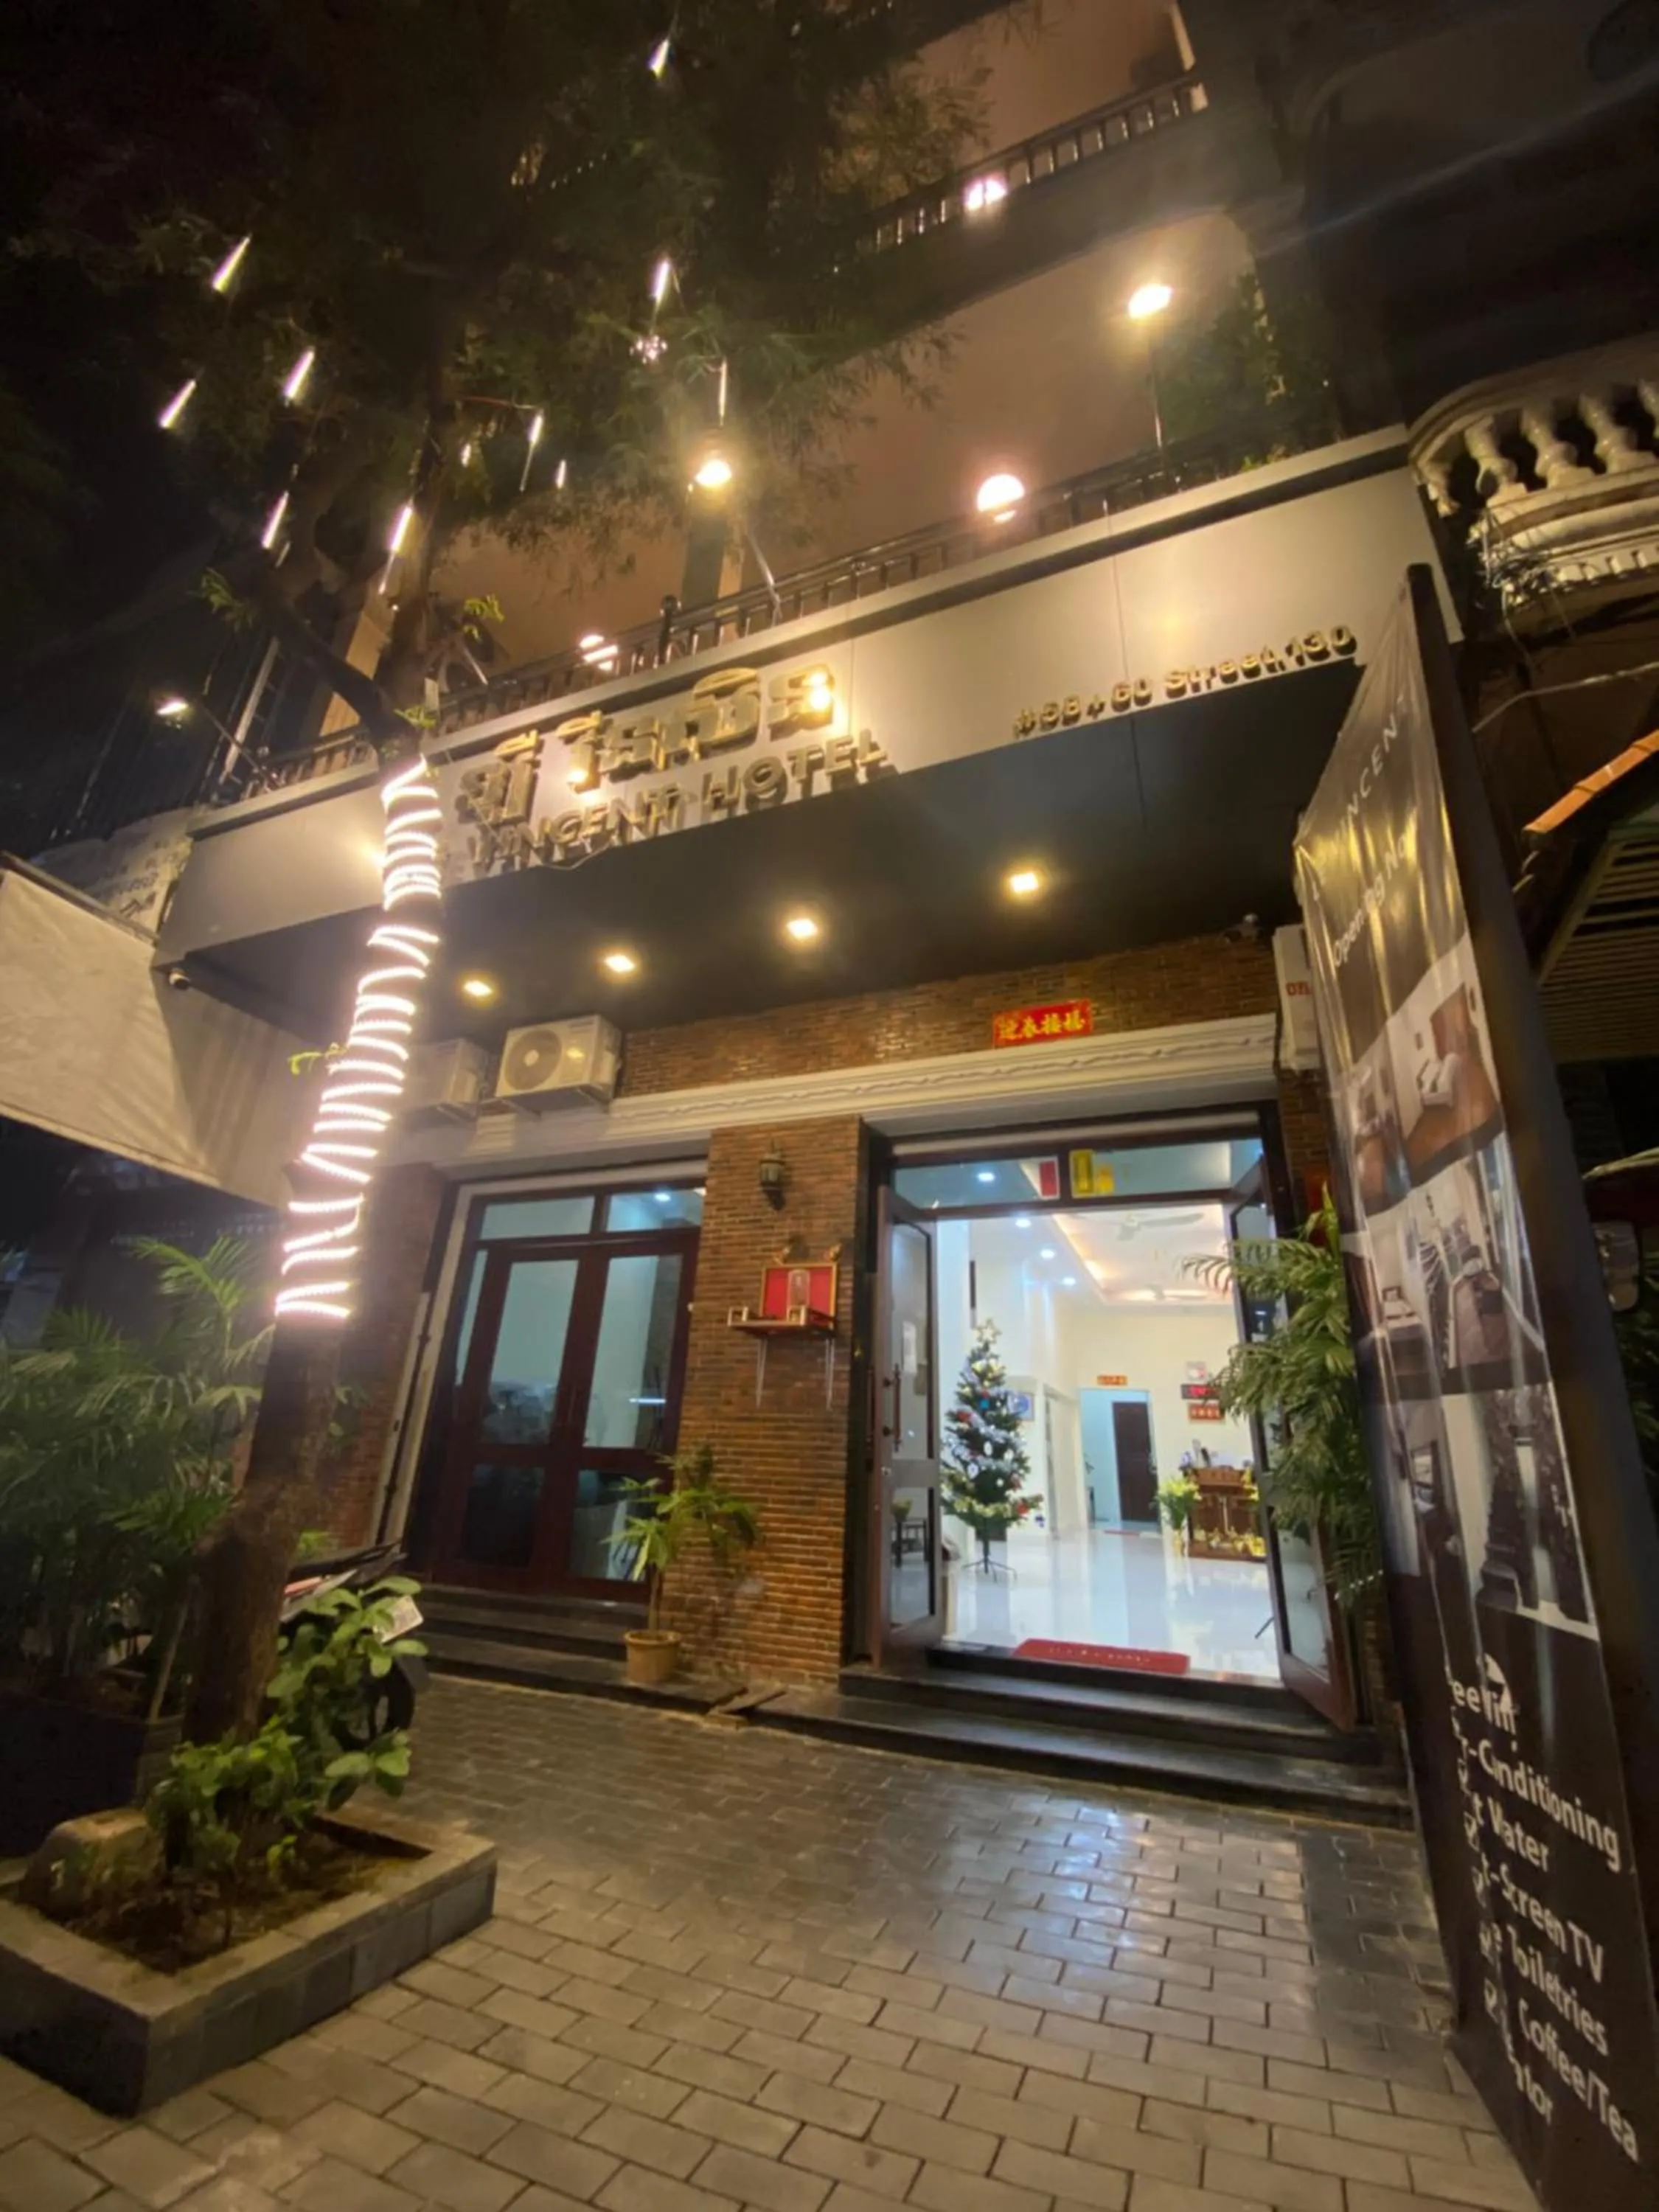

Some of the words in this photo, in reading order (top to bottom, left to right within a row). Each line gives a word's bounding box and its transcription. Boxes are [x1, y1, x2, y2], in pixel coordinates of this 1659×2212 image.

[469, 786, 683, 867] VINCENT
[700, 727, 888, 815] HOTEL
[1566, 1920, 1604, 1984] TV
